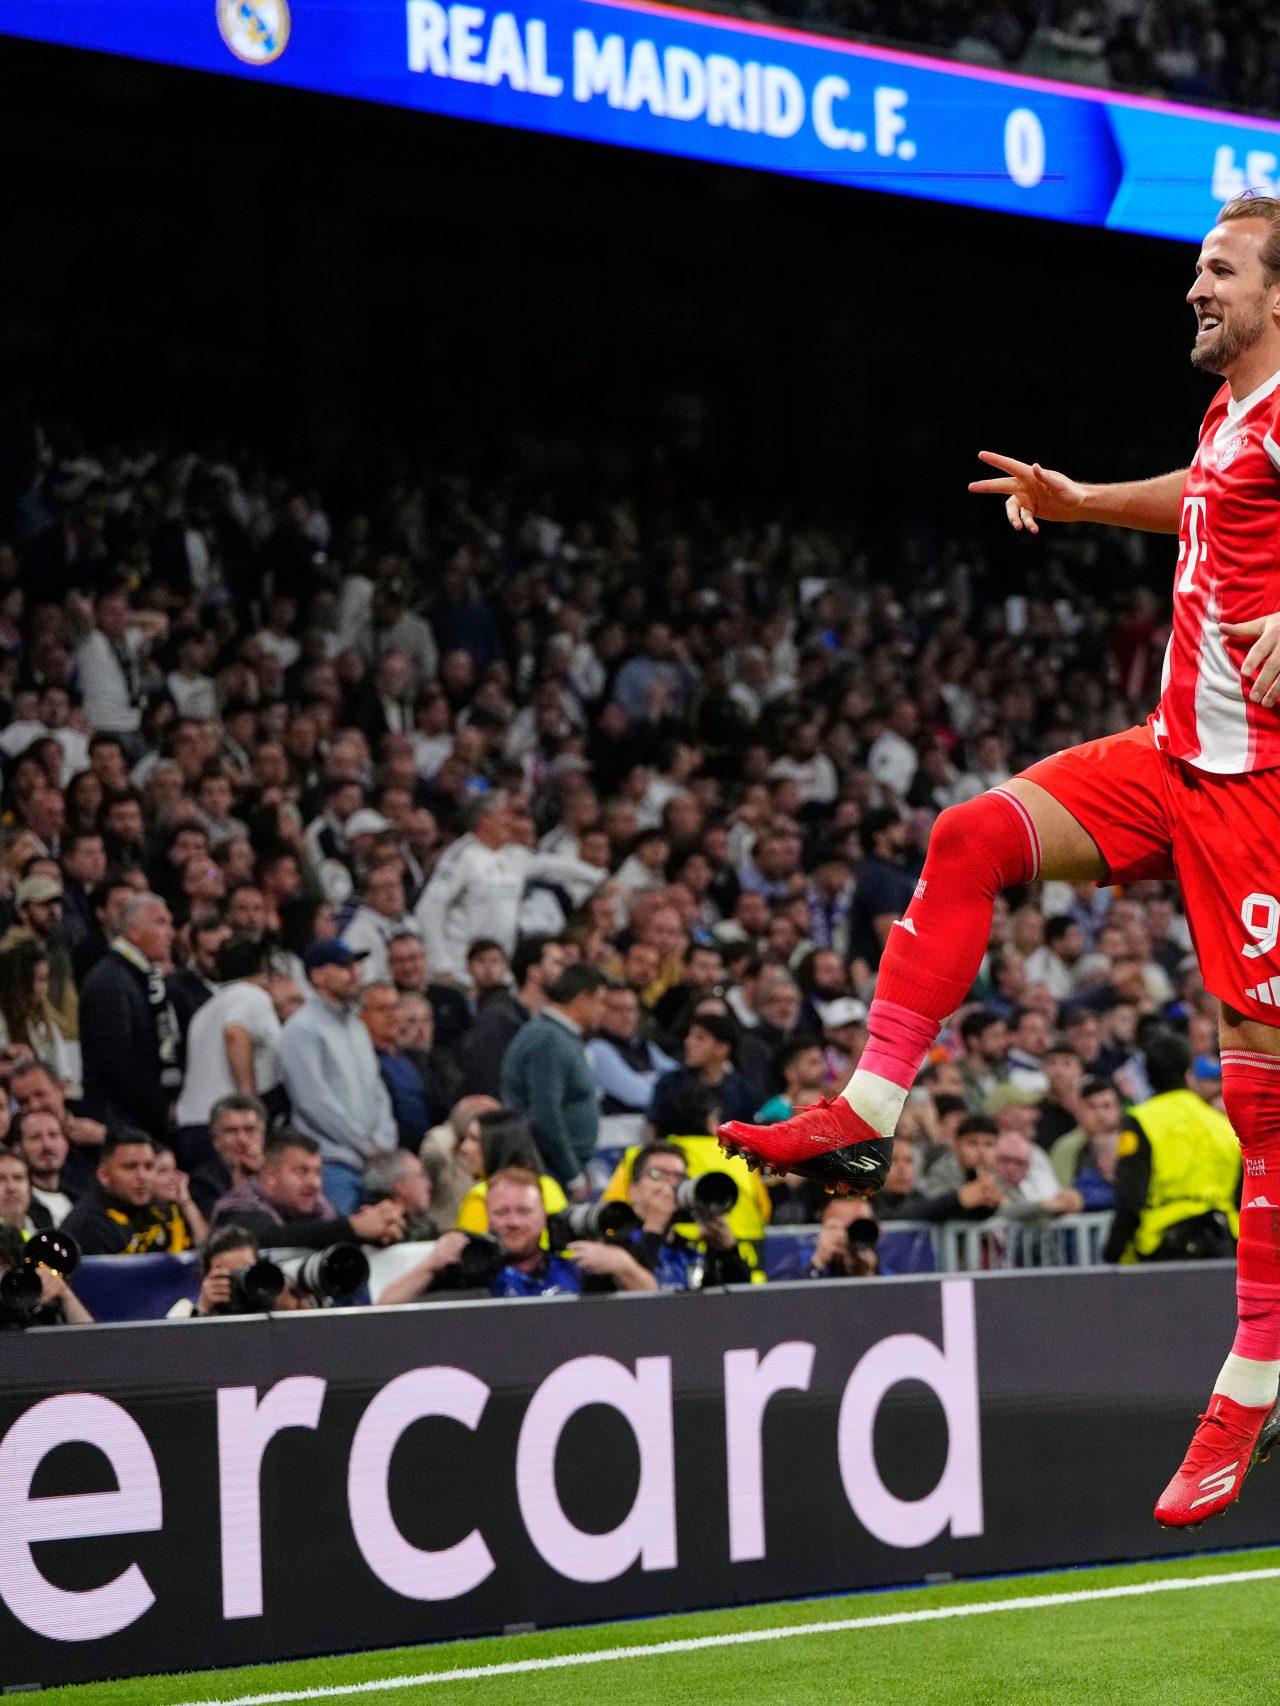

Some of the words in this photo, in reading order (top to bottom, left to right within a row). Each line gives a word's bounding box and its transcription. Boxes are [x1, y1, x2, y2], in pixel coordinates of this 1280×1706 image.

[406, 0, 563, 97] REAL
[574, 28, 806, 138] MADRID
[812, 75, 867, 152] C.
[874, 85, 916, 160] F.
[1003, 107, 1046, 188] 0
[1241, 892, 1280, 959] 9
[0, 1279, 984, 1643] ercard
